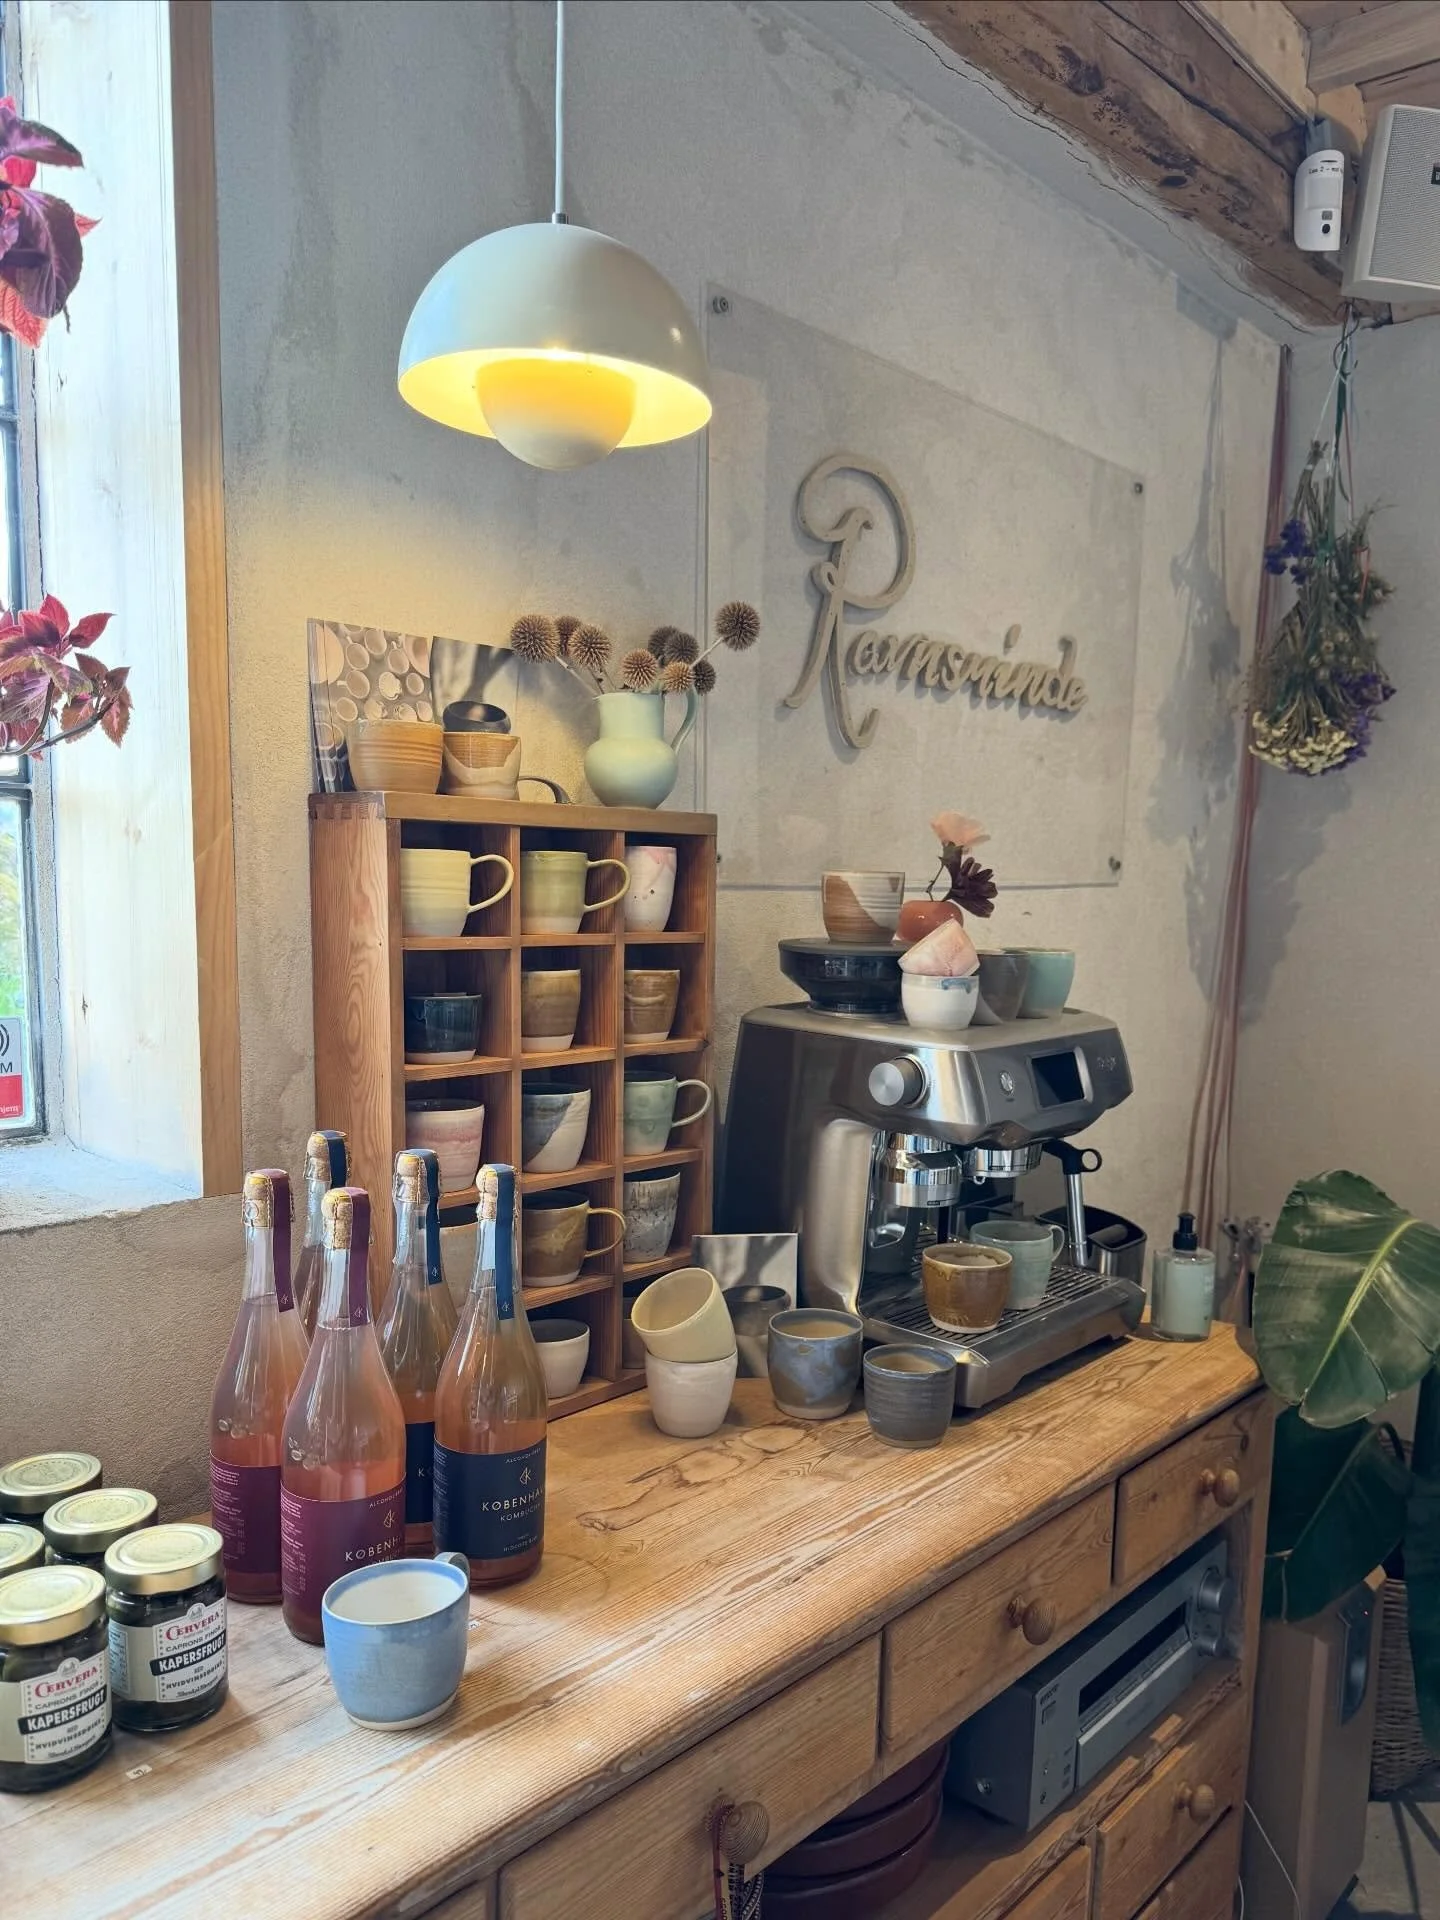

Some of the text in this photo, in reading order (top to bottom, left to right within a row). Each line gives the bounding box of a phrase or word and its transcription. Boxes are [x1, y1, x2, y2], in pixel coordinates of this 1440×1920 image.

[166, 1612, 220, 1640] CERVERA
[159, 1633, 225, 1672] KAPERSFRUGT
[34, 1666, 98, 1698] CERVERA
[27, 1689, 105, 1731] KAPERSFRUGT
